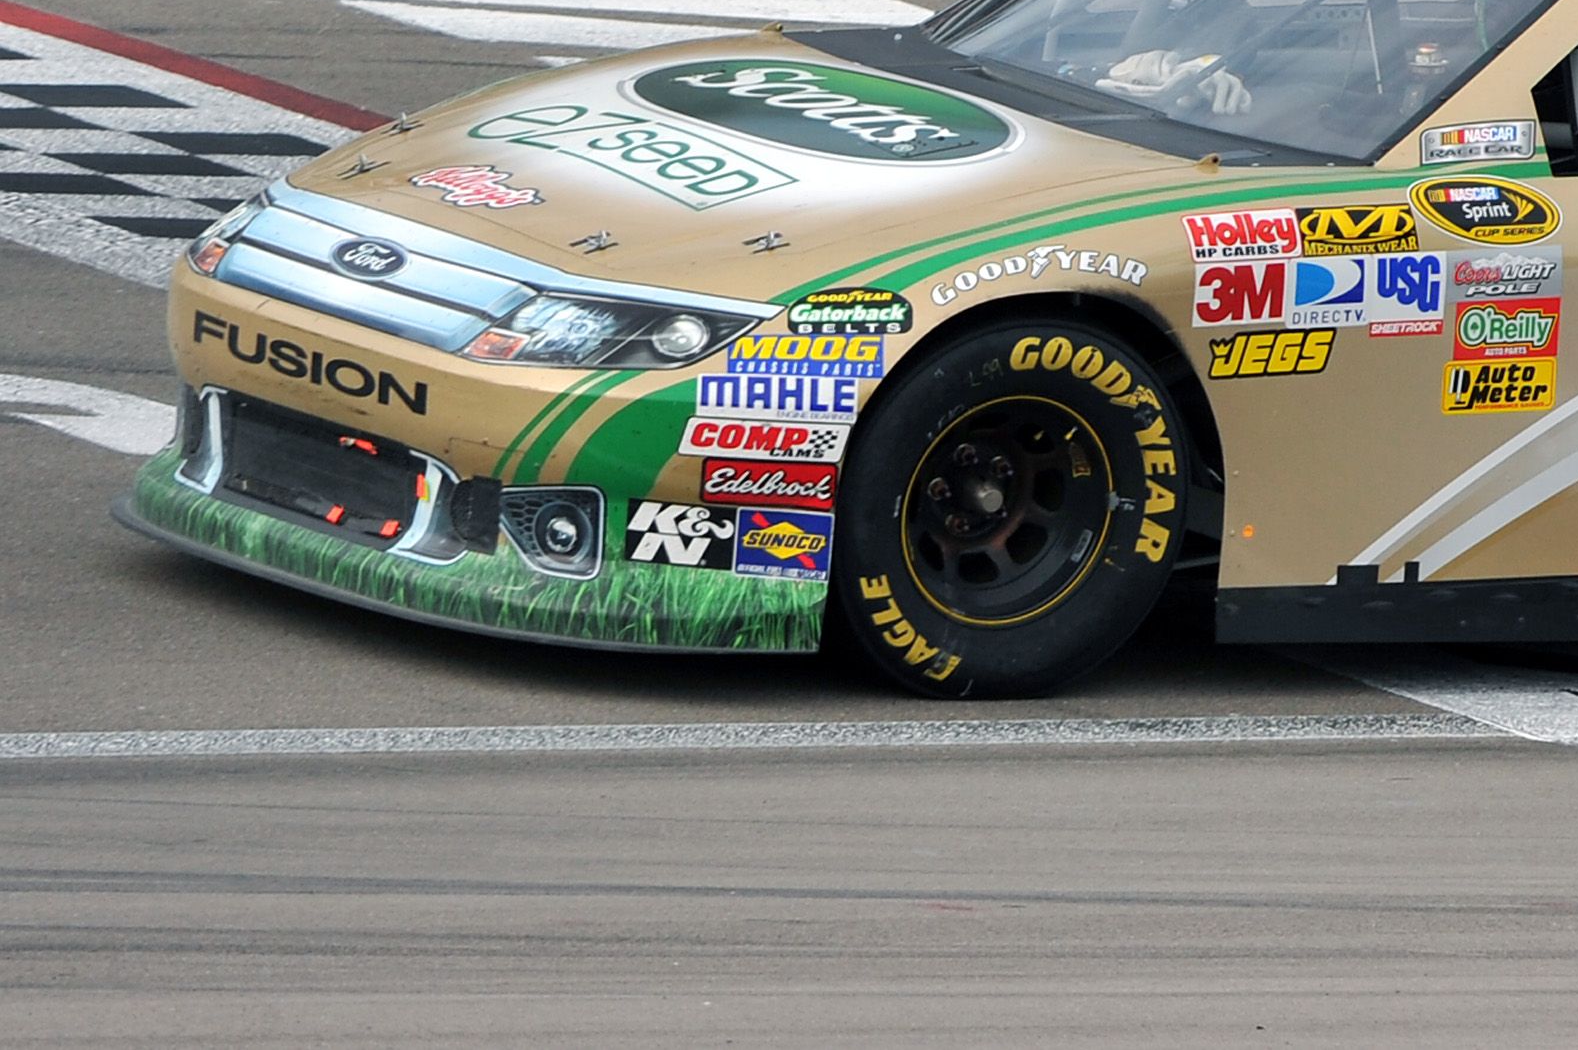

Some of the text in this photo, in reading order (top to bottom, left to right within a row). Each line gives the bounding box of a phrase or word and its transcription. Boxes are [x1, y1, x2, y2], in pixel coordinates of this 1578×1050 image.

[673, 67, 960, 143] Scotts
[1463, 126, 1516, 143] NASCAR
[1429, 144, 1523, 158] RACE CAR
[1449, 186, 1499, 201] NASCAR
[1461, 201, 1513, 222] Sprint
[1186, 213, 1296, 254] Holley
[1474, 226, 1545, 237] CUP SERIES
[342, 242, 398, 271] Ford
[1196, 245, 1280, 259] HP CARBS
[1304, 237, 1419, 257] MECHANIX WEAR
[1454, 260, 1557, 285] Coors LIGHT
[1195, 261, 1286, 324] 3M
[1377, 255, 1441, 313] USG
[1465, 282, 1541, 297] POLE
[789, 303, 906, 323] Gatorback
[1291, 309, 1364, 325] DIRECTV
[798, 322, 902, 334] BELTS
[1370, 321, 1442, 335] SHEETROCK
[1462, 309, 1549, 343] O'Reilly
[729, 336, 881, 361] MOOG
[1210, 330, 1335, 378] JEGS
[193, 308, 428, 416] FUSION
[736, 360, 875, 377] CHASSIS PARTS
[1475, 363, 1536, 384] Auto
[700, 375, 857, 413] MAHLE
[1471, 383, 1548, 404] Meter
[690, 422, 809, 451] COMP
[769, 447, 826, 459] CAMS
[704, 467, 833, 500] Edelbrock
[745, 531, 824, 551] SUNOCO
[859, 572, 963, 683] EAGLE
